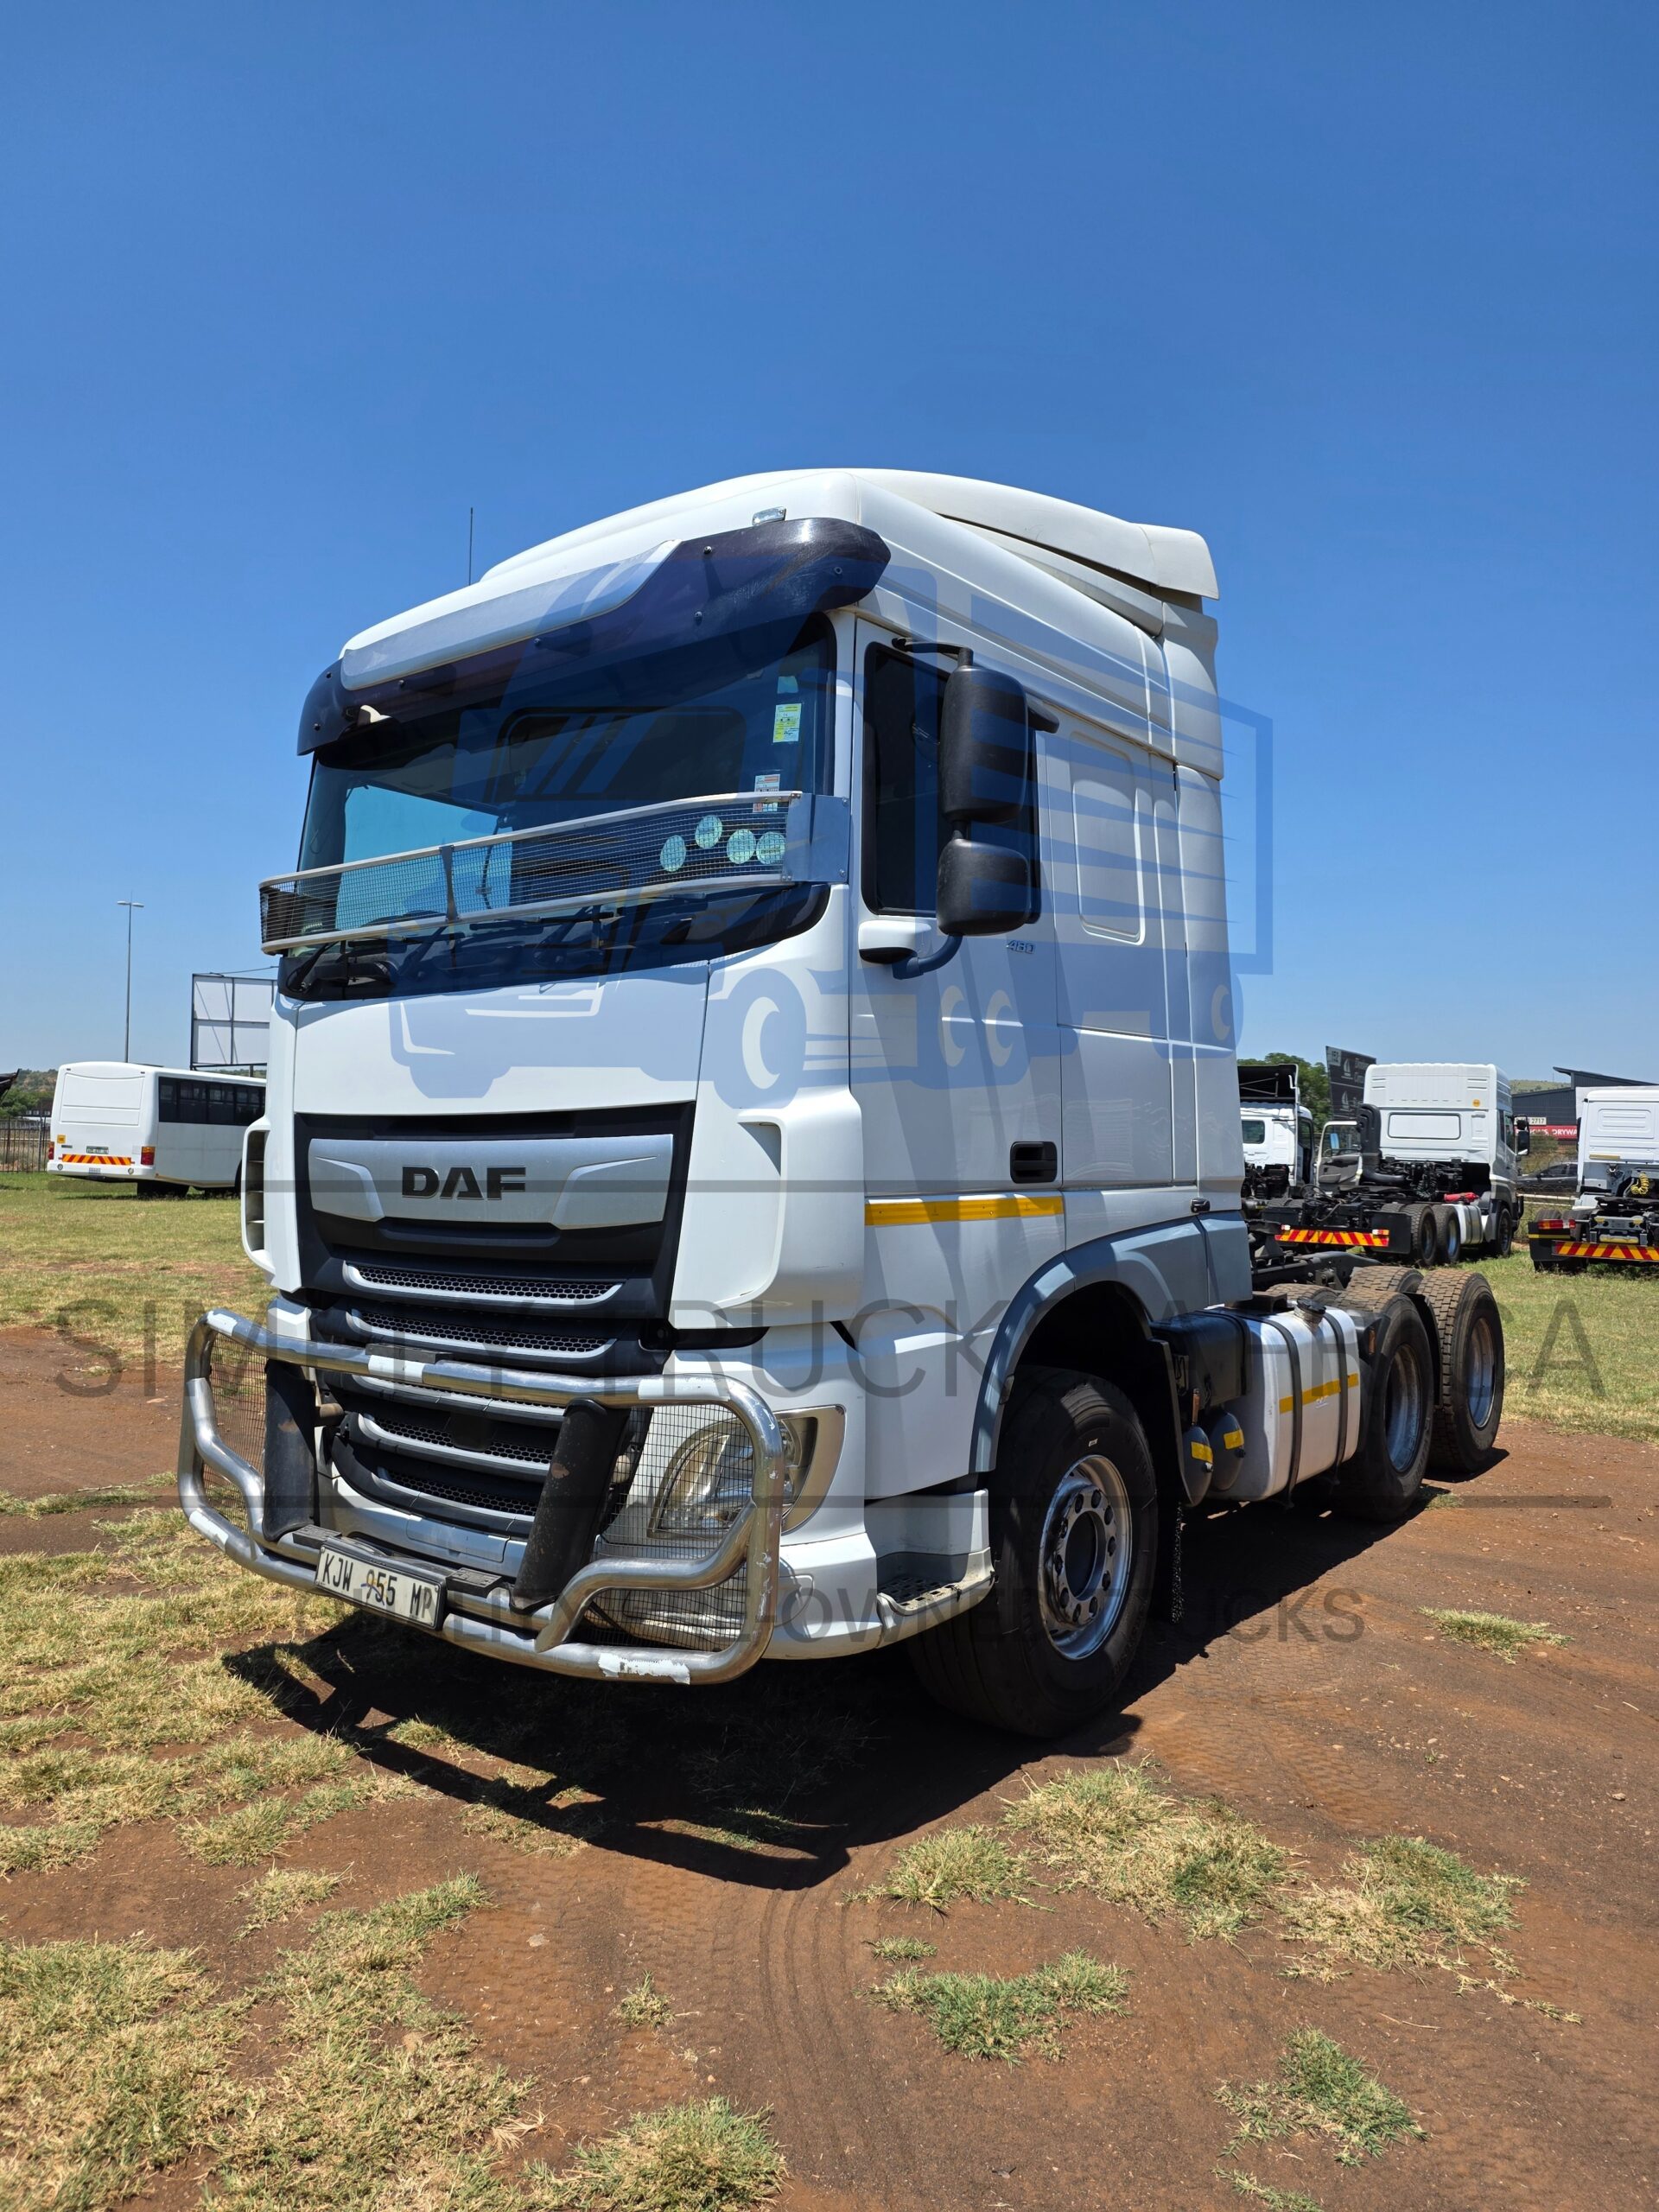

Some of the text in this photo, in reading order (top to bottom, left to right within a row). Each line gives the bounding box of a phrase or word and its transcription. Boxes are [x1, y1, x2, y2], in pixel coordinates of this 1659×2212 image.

[402, 1166, 526, 1200] DAF
[322, 1553, 353, 1592] KJW
[410, 1582, 433, 1618] MP
